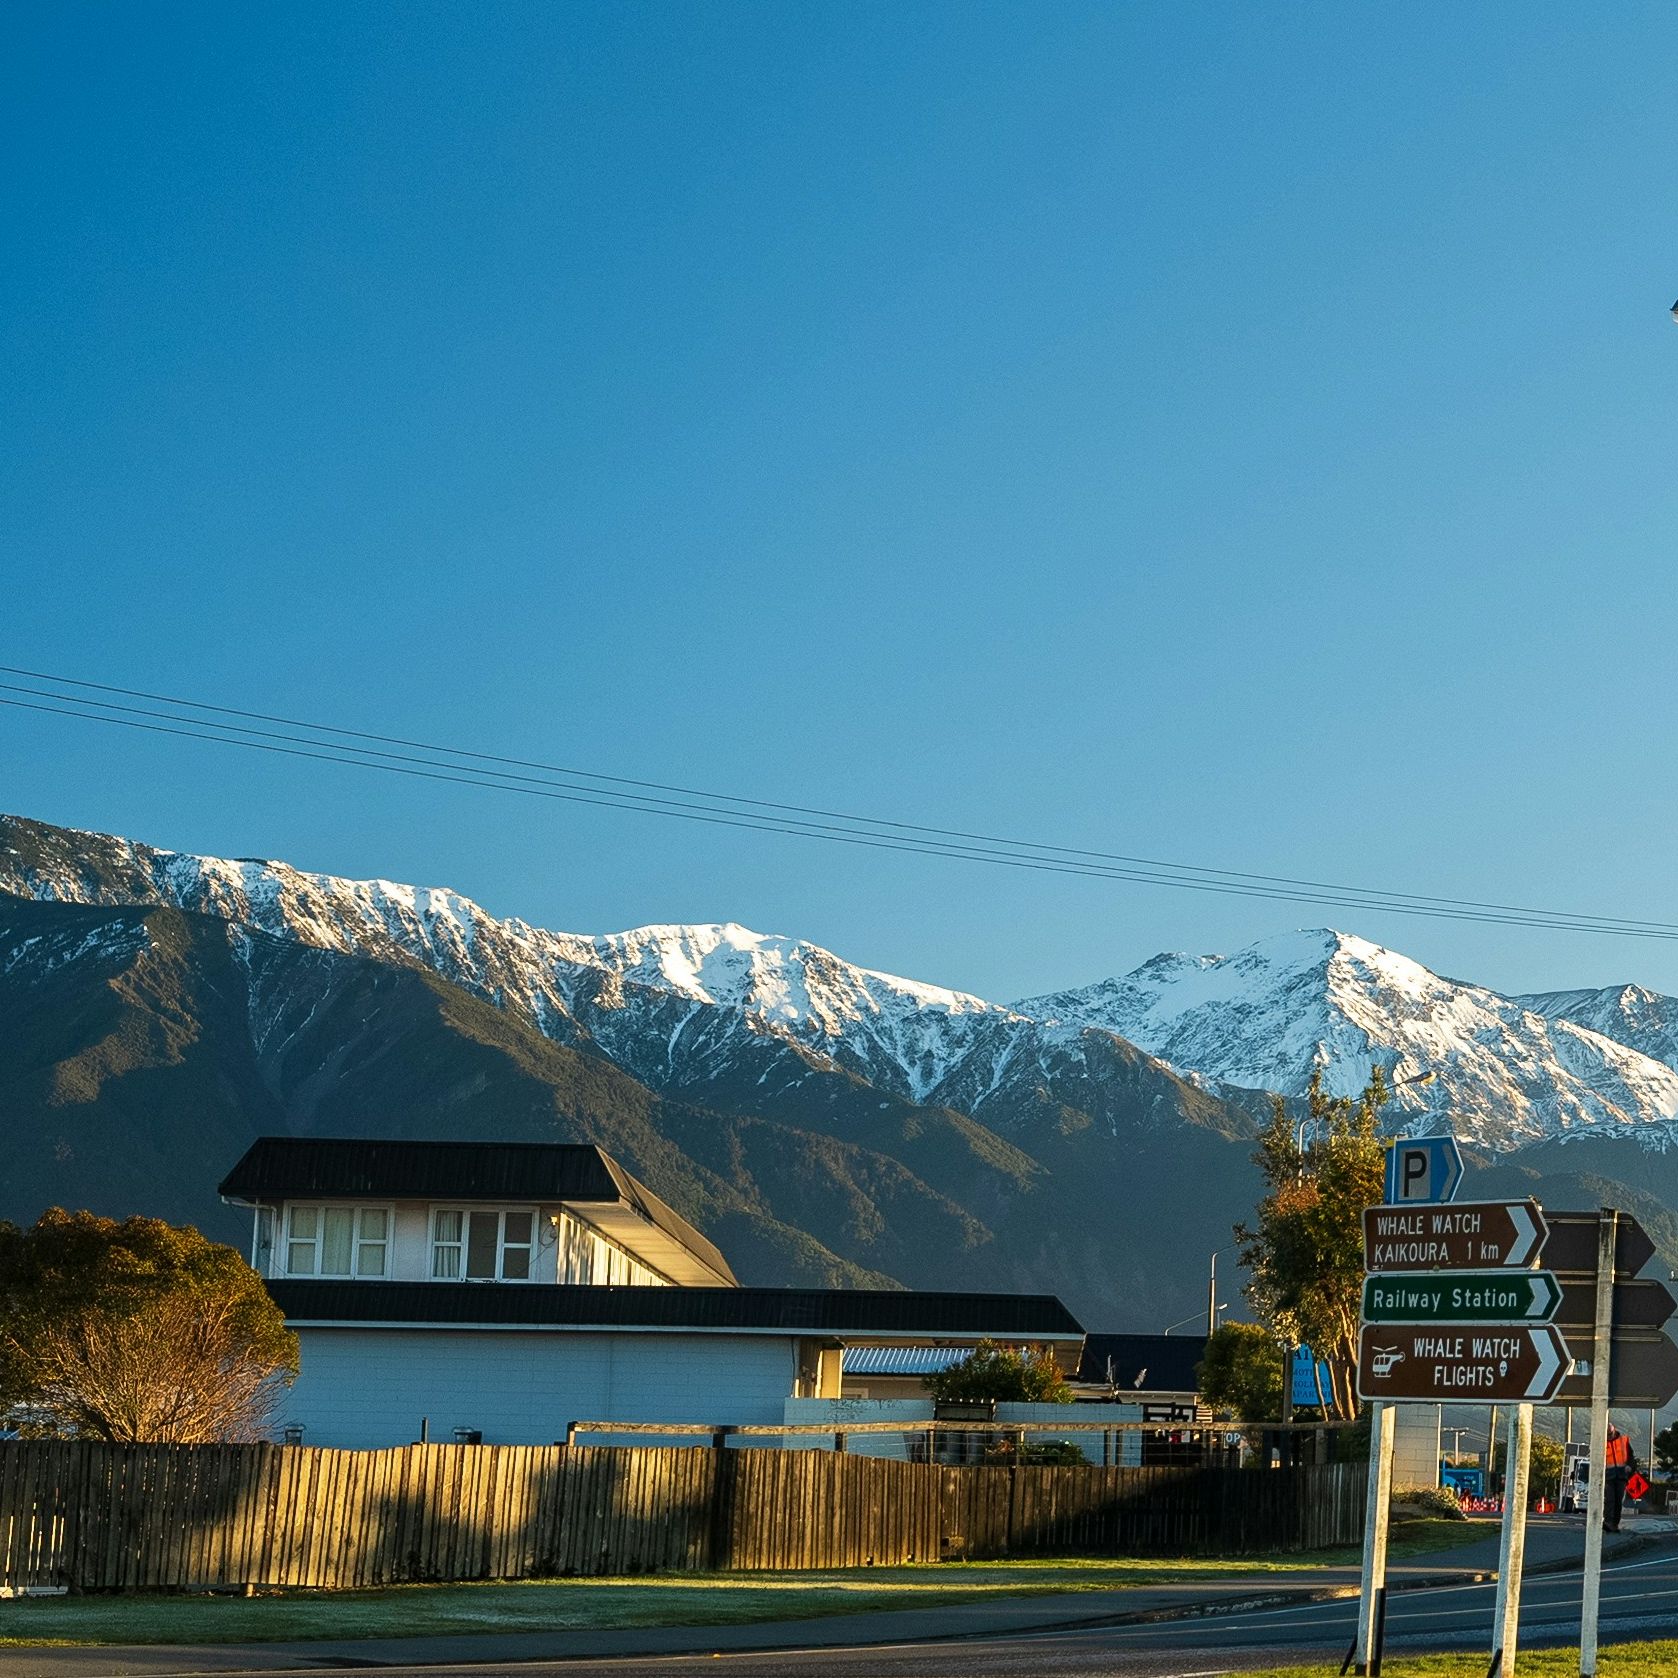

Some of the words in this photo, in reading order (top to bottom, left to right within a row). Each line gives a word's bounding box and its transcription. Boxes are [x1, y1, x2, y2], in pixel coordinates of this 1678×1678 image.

[1404, 1151, 1427, 1197] P
[1377, 1215, 1424, 1236] WHALE
[1432, 1213, 1481, 1234] WATCH
[1374, 1242, 1449, 1263] KAIKOURA
[1467, 1241, 1472, 1260] 1
[1481, 1241, 1499, 1260] km
[1373, 1289, 1441, 1312] Railway
[1452, 1288, 1517, 1308] Station
[1414, 1338, 1464, 1358] WHALE
[1472, 1338, 1520, 1358] WATCH
[1434, 1366, 1494, 1386] FLIGHTS
